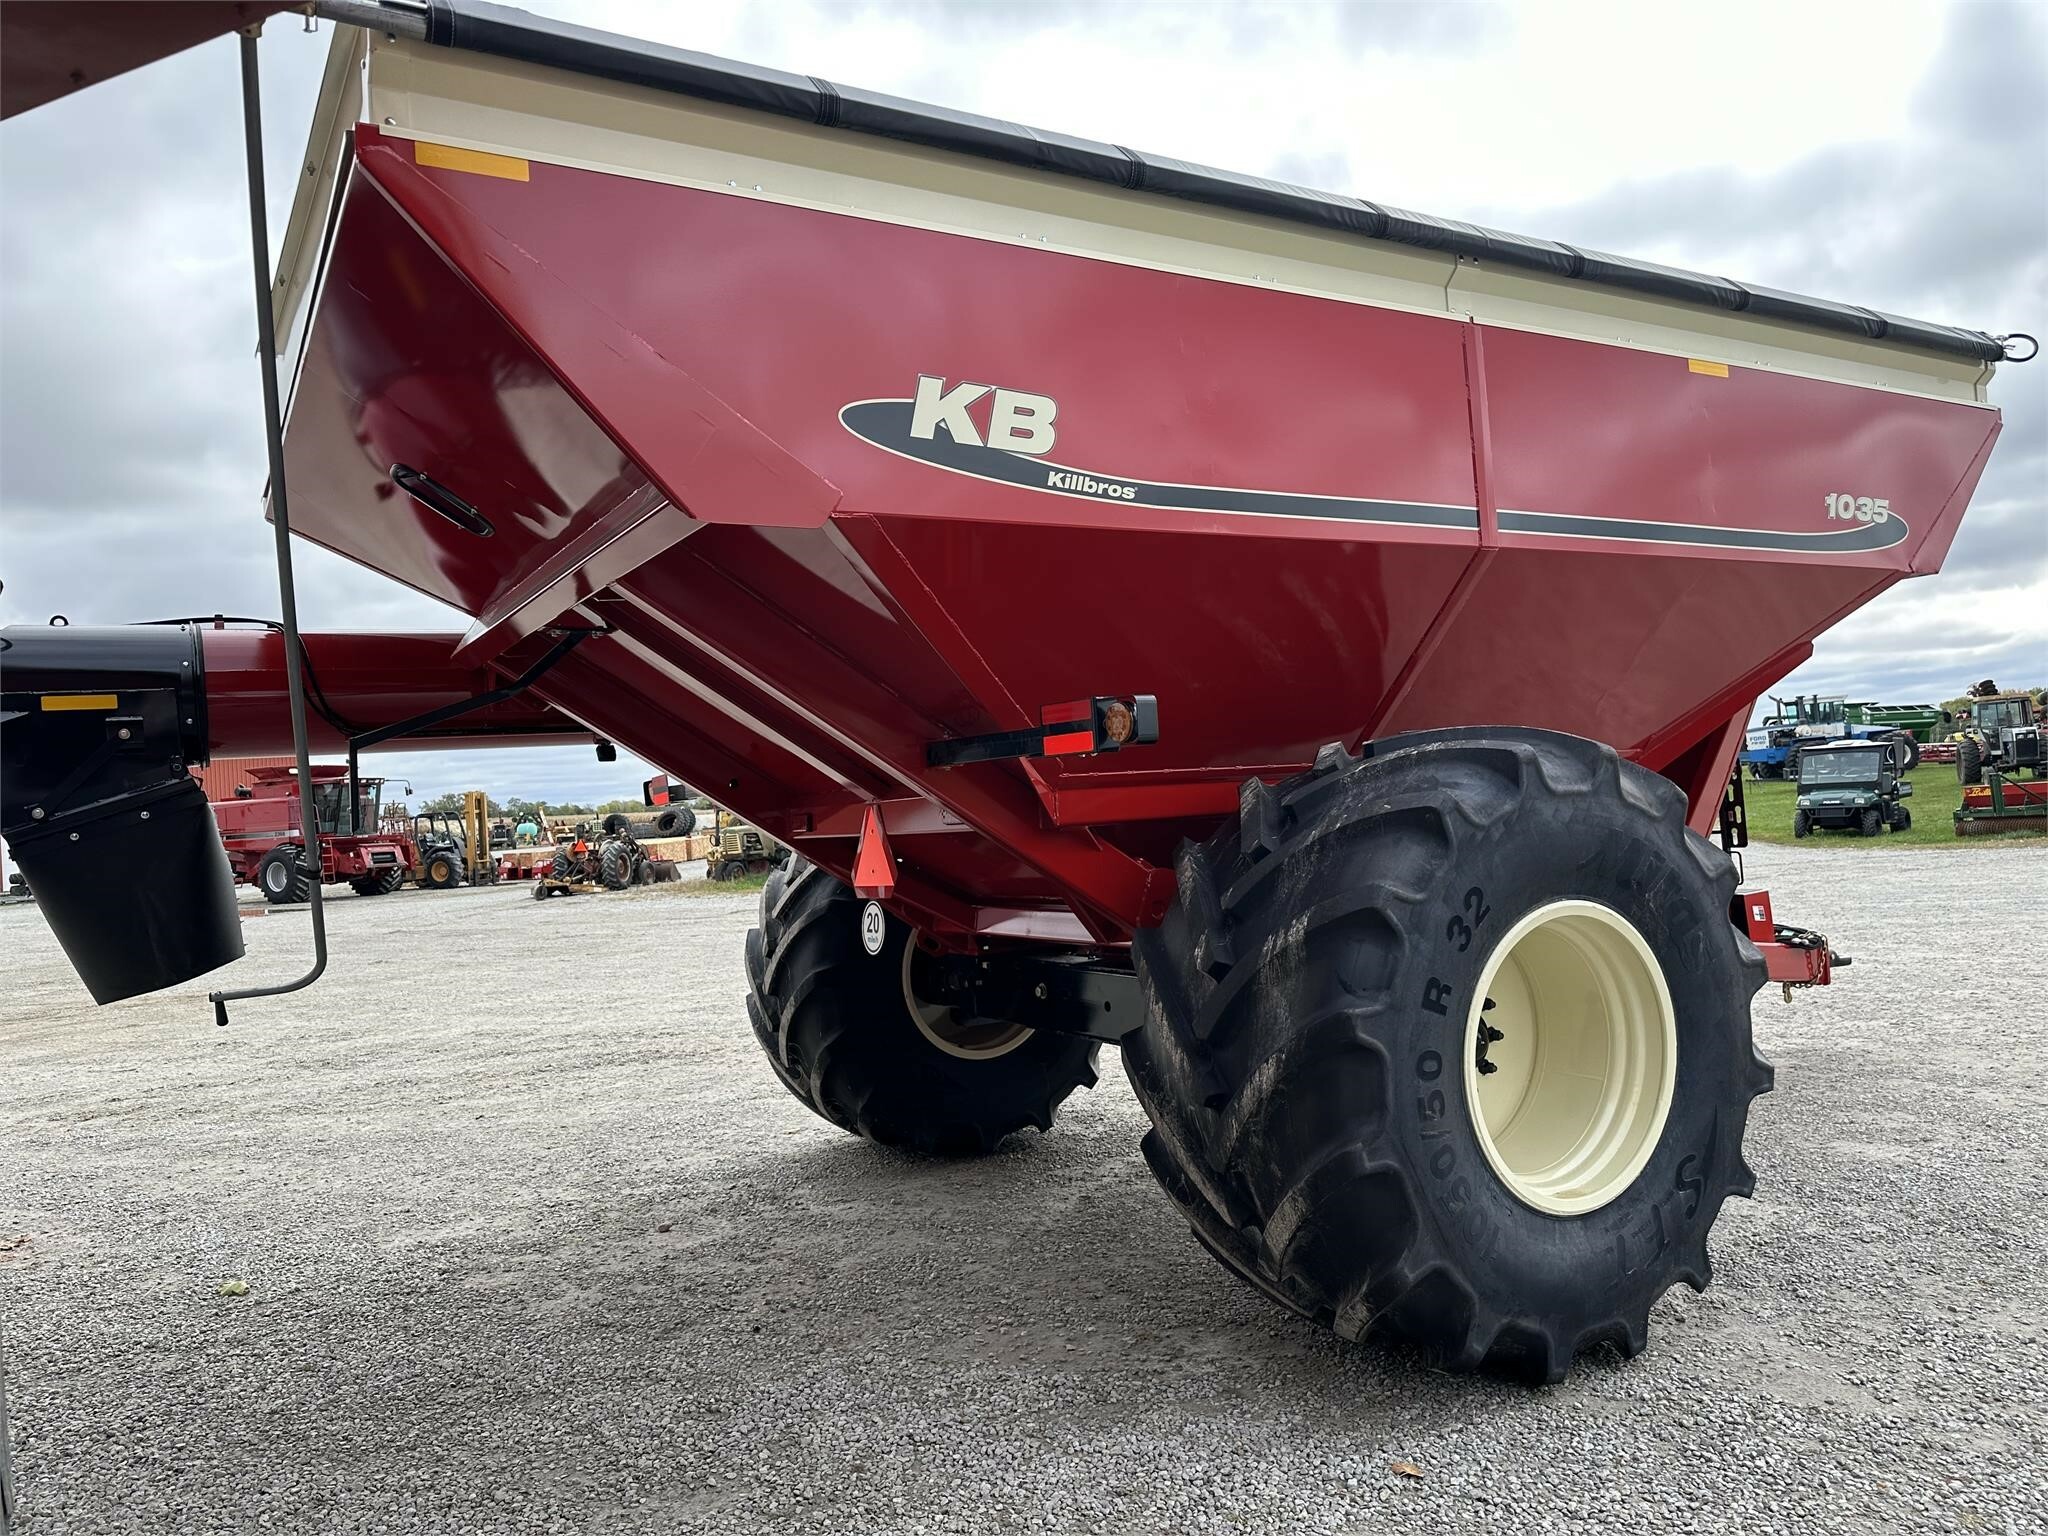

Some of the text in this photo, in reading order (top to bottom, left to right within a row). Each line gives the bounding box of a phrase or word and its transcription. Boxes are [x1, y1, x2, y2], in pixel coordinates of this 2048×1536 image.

[909, 374, 1056, 455] KB
[1047, 471, 1136, 499] Killbros
[1825, 492, 1889, 523] 1035
[866, 912, 880, 933] 20
[1421, 976, 1453, 1016] R
[1446, 886, 1492, 953] 32
